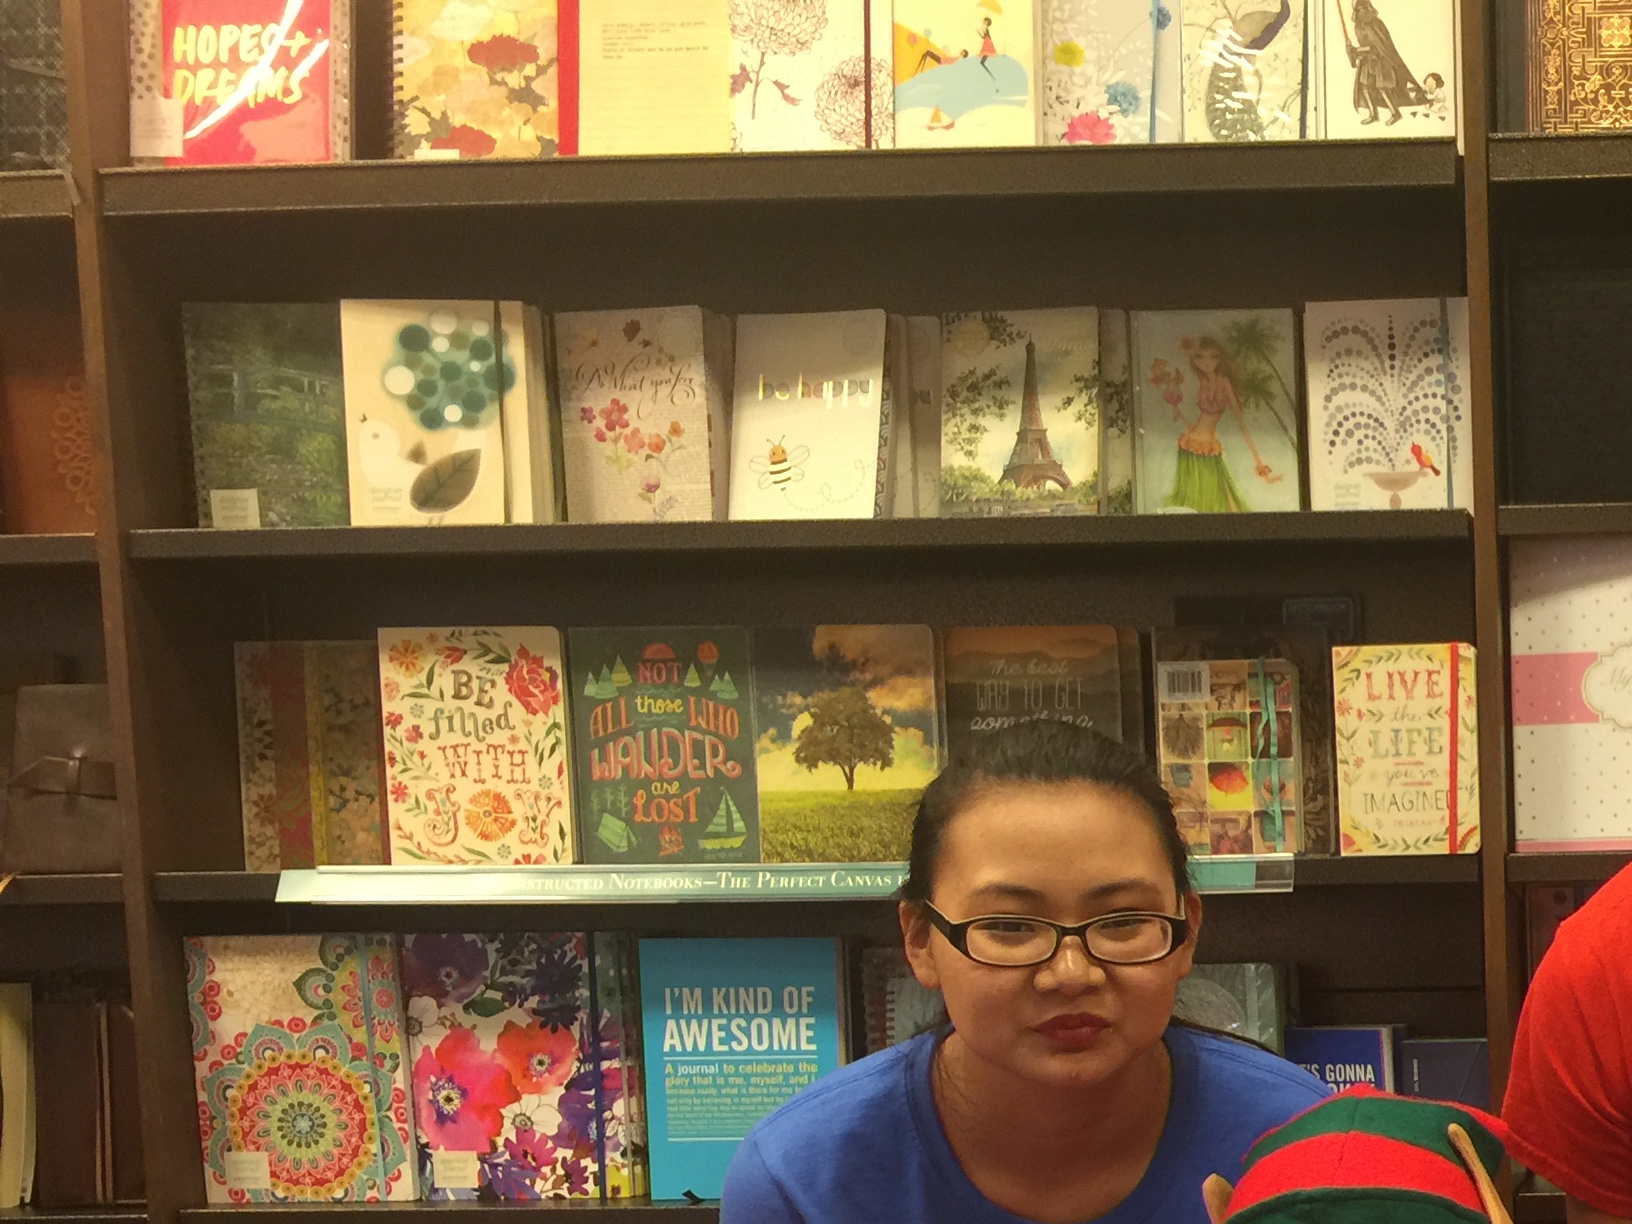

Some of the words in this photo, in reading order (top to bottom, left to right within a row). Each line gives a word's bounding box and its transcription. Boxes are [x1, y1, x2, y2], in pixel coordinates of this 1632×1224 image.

[173, 23, 281, 64] HOPES
[172, 67, 309, 108] DREAMS
[758, 372, 790, 400] be
[797, 371, 874, 409] happy
[451, 669, 497, 709] BE
[636, 662, 681, 685] NOT
[1365, 669, 1443, 702] LIVE
[429, 701, 515, 742] filled
[590, 696, 634, 739] ALL
[636, 695, 684, 714] those
[688, 695, 740, 740] WHO
[591, 727, 742, 781] WANDER
[1369, 726, 1443, 759] LIFE
[438, 742, 531, 785] WITH
[633, 787, 700, 823] LOST
[651, 781, 681, 796] are
[757, 871, 827, 888] PERFECT
[831, 870, 893, 887] CANVAS
[664, 987, 703, 1015] I'M
[712, 986, 773, 1014] KIND
[783, 986, 815, 1014] OF
[663, 1017, 817, 1052] AWESOME
[665, 1064, 673, 1074] A
[677, 1062, 719, 1076] journal
[723, 1063, 735, 1073] to
[739, 1061, 794, 1073] celebrate
[1326, 1063, 1375, 1081] GONNA
